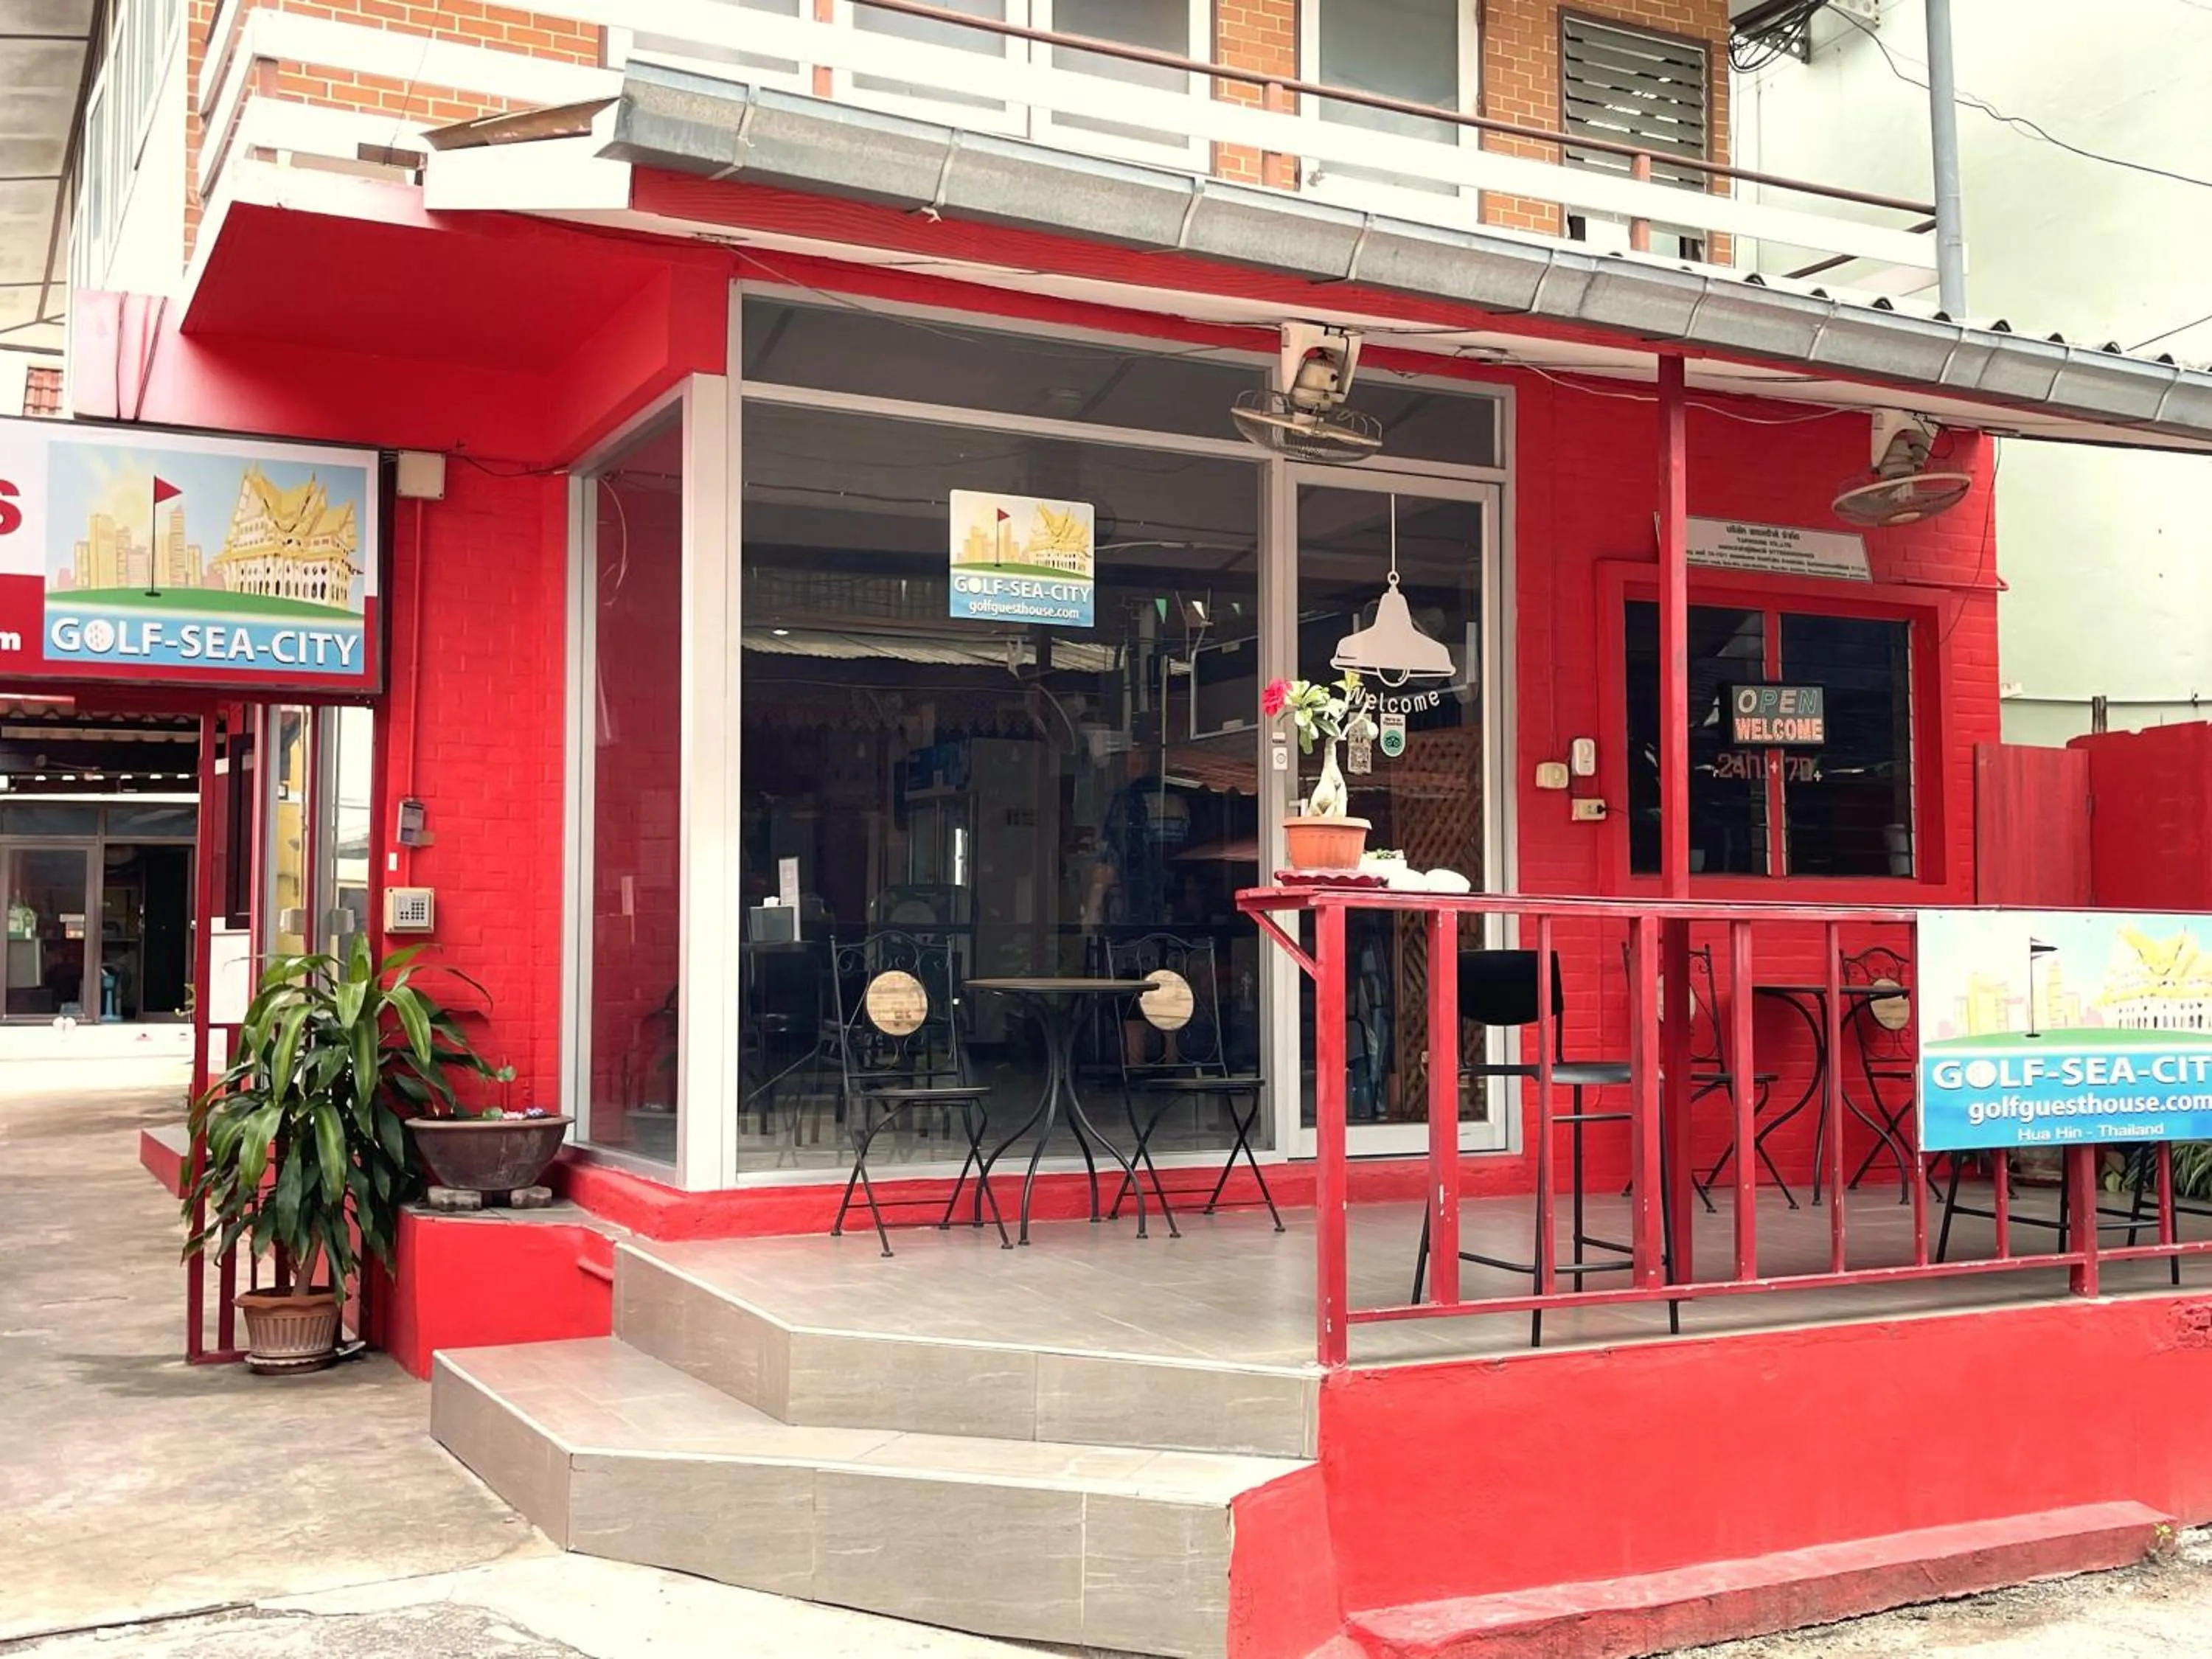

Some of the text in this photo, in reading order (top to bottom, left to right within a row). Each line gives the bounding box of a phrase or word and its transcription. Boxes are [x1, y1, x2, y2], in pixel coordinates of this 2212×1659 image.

[954, 575, 1091, 602] GOLF-SEA-CITY
[968, 599, 1080, 619] golfguesthouse.com
[50, 616, 359, 667] GOLF-SEA-CITY
[1349, 687, 1440, 714] Welcome
[1738, 689, 1818, 714] OPEN
[1734, 717, 1823, 741] WELCOME
[1969, 1092, 2212, 1125] golfguesthouse.com
[2018, 1128, 2051, 1141] Hua
[2056, 1126, 2082, 1139] Hin
[2099, 1121, 2165, 1138] Thailand
